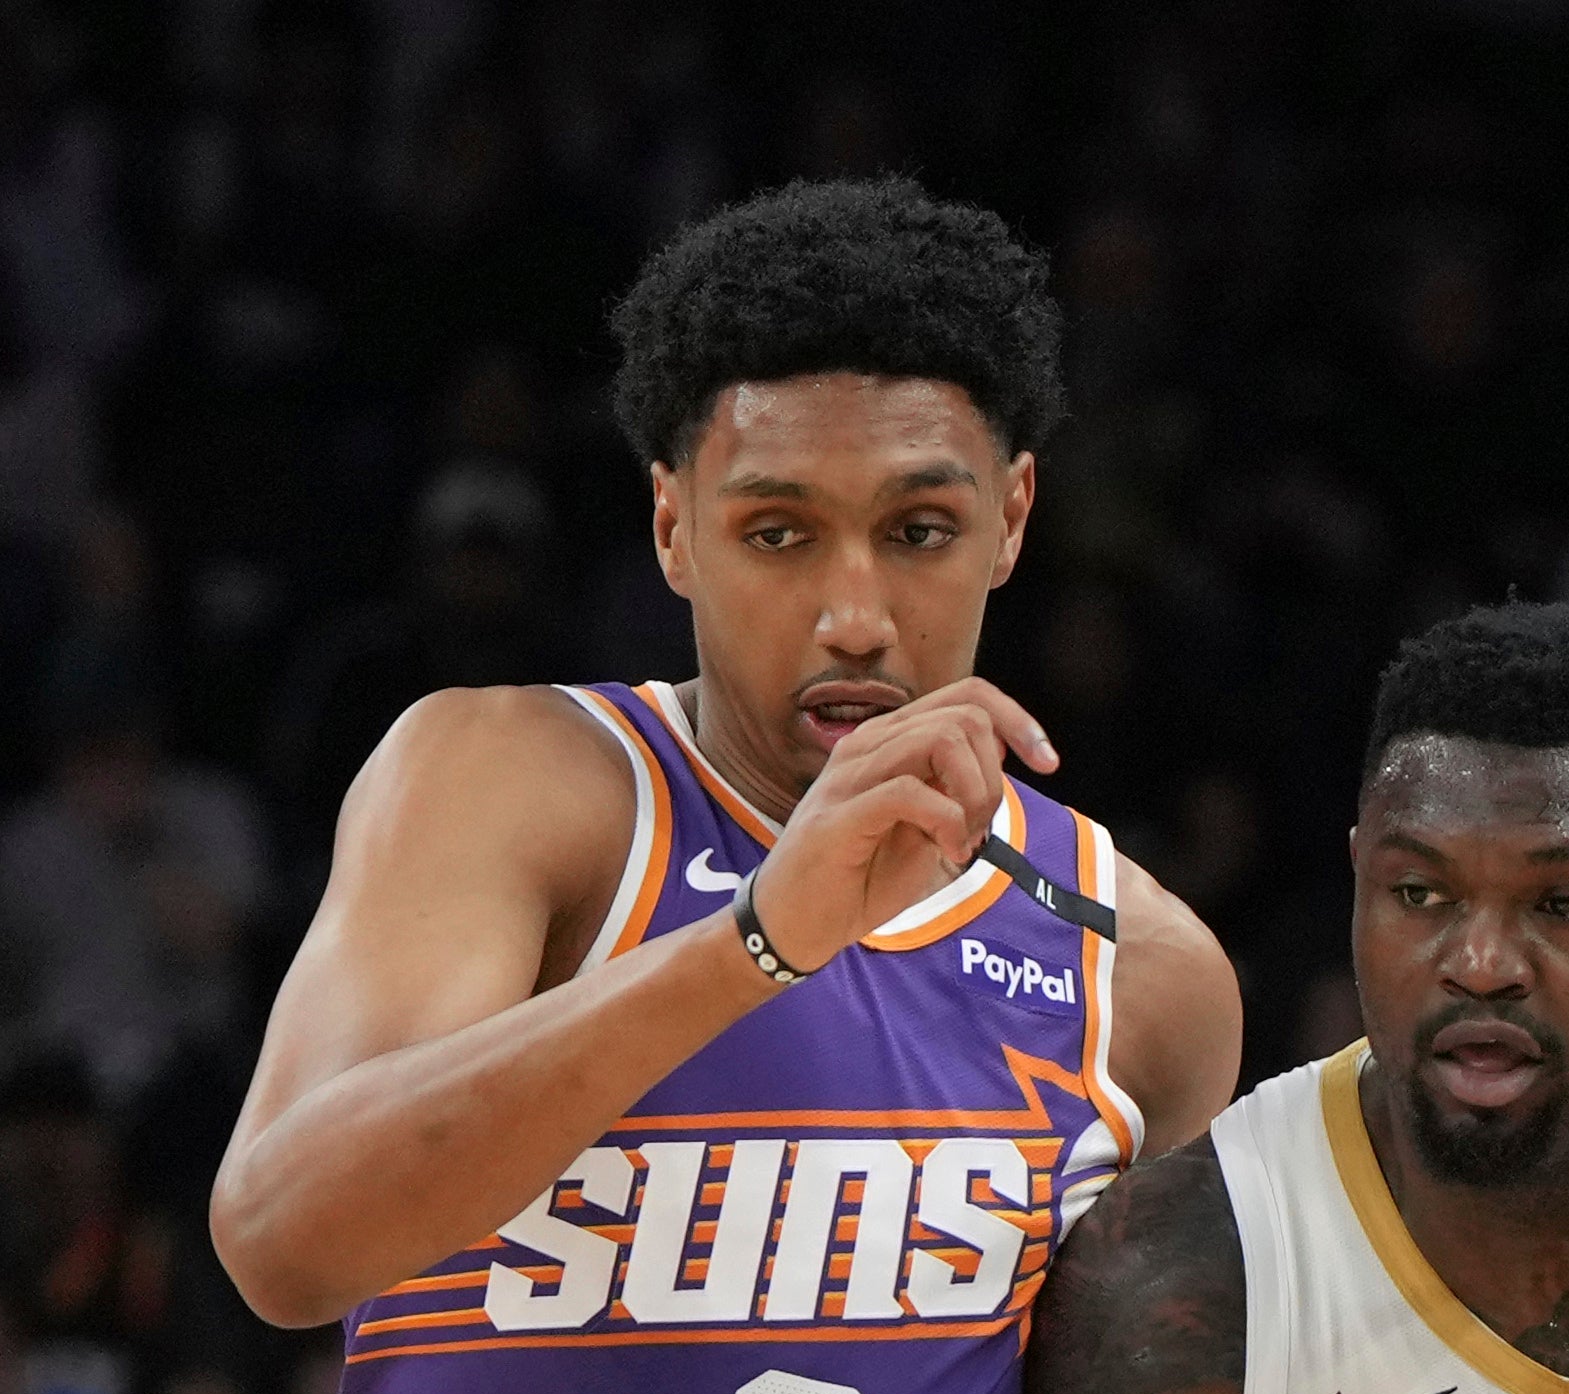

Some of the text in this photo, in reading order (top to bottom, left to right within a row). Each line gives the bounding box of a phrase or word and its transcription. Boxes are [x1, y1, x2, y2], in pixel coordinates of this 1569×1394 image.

[1035, 880, 1057, 910] AL
[960, 938, 1076, 1005] PayPal
[483, 1137, 1030, 1332] SUNS
